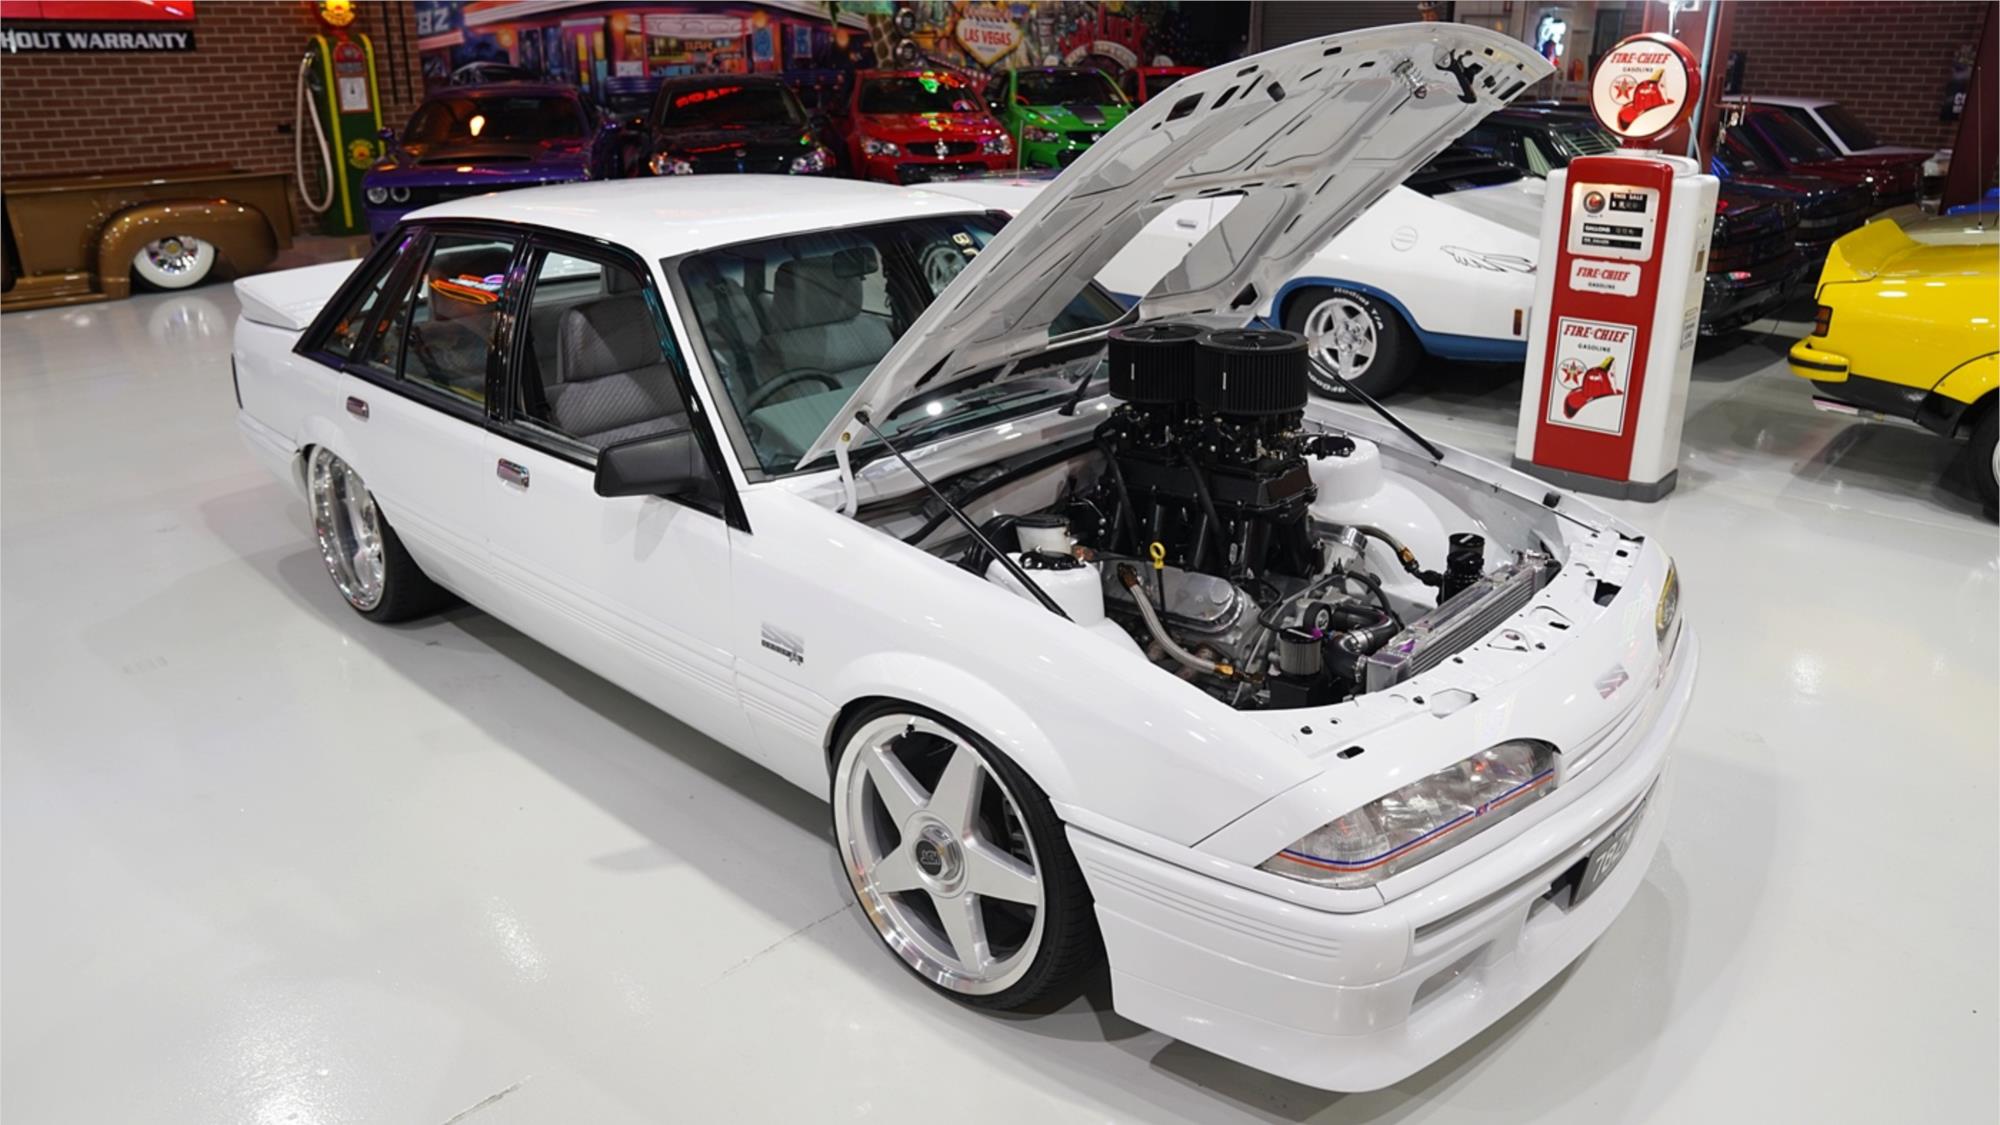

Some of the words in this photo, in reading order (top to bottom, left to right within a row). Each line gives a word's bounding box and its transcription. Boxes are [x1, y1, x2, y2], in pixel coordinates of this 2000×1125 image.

[66, 32, 187, 49] WARRANTY
[964, 28, 979, 43] LAS
[981, 31, 1012, 46] VEGAS
[1610, 52, 1671, 64] FIRE-CHIEF
[1576, 266, 1630, 281] FIRE-CHIEF
[1588, 282, 1615, 290] GASOLINE
[1563, 324, 1629, 343] FIRE-CHIEF
[1578, 342, 1611, 353] GASOLINE
